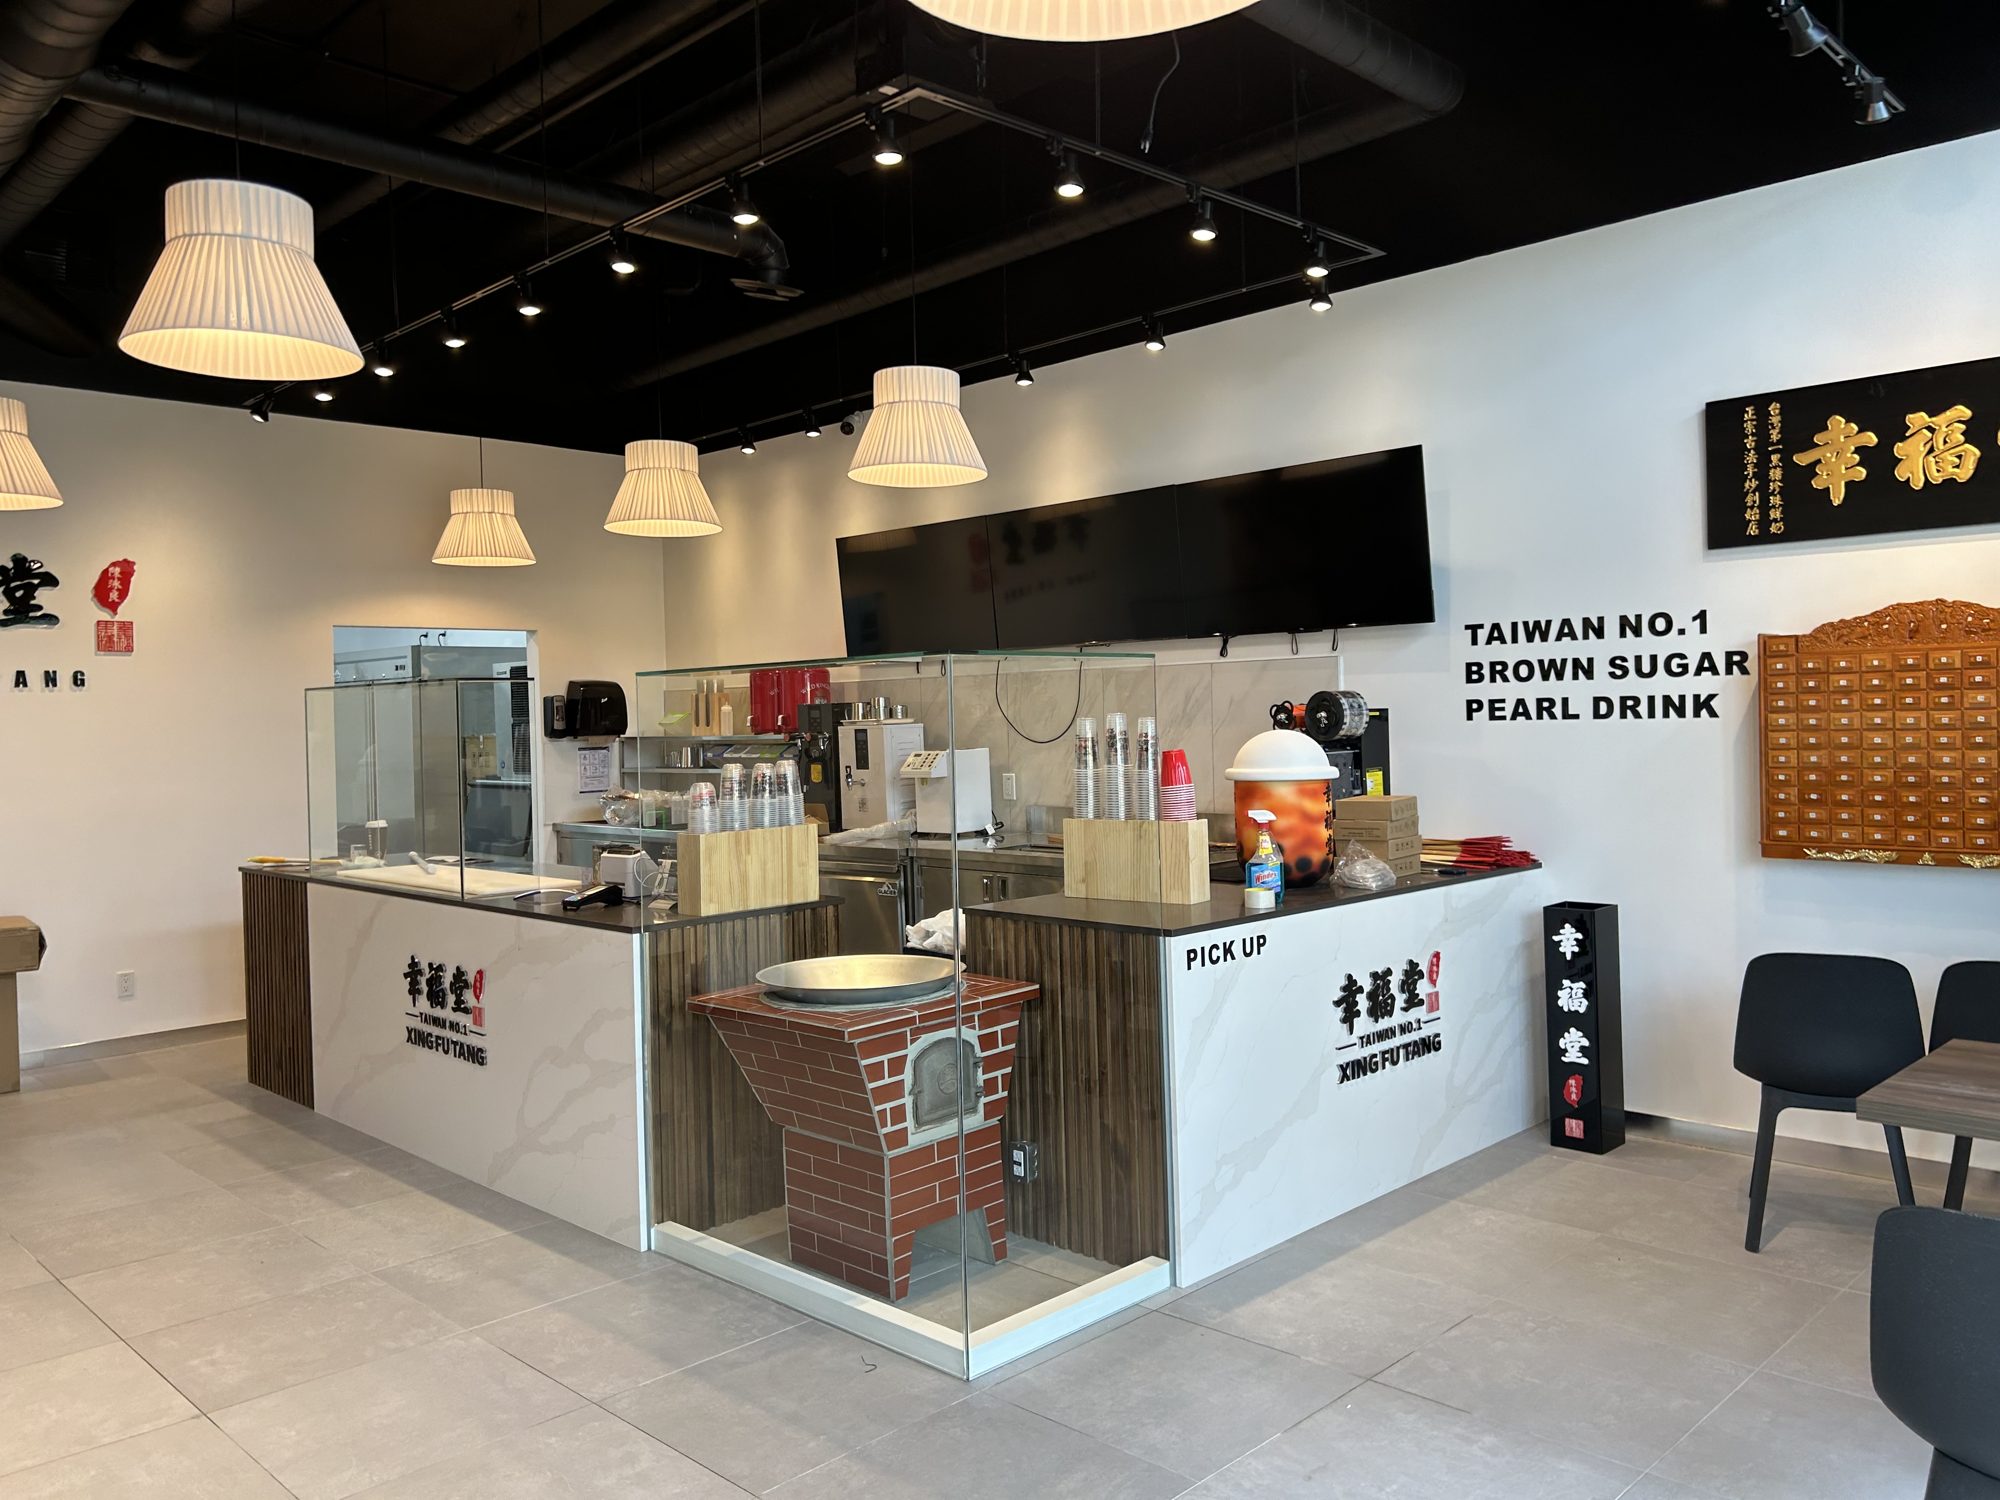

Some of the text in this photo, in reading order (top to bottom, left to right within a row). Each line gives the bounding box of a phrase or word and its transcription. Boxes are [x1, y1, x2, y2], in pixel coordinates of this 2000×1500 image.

[1793, 405, 2000, 507] 幸福
[0, 553, 60, 628] 堂
[1464, 609, 1708, 646] TAIWAN NO.1
[1465, 650, 1751, 684] BROWN SUGAR
[1466, 693, 1720, 721] PEARL DRINK
[1254, 871, 1277, 885] Windex
[1186, 934, 1267, 970] PICK UP
[403, 955, 472, 1015] 幸福堂
[1332, 959, 1425, 1036] 幸福堂
[1552, 923, 1590, 1065] 幸福堂
[419, 1012, 468, 1036] TAIWAN NO.1
[1358, 1018, 1422, 1049] TAIWAN NO.1
[406, 1026, 487, 1066] XING FU TANG
[1337, 1033, 1441, 1084] XING FU TANG
